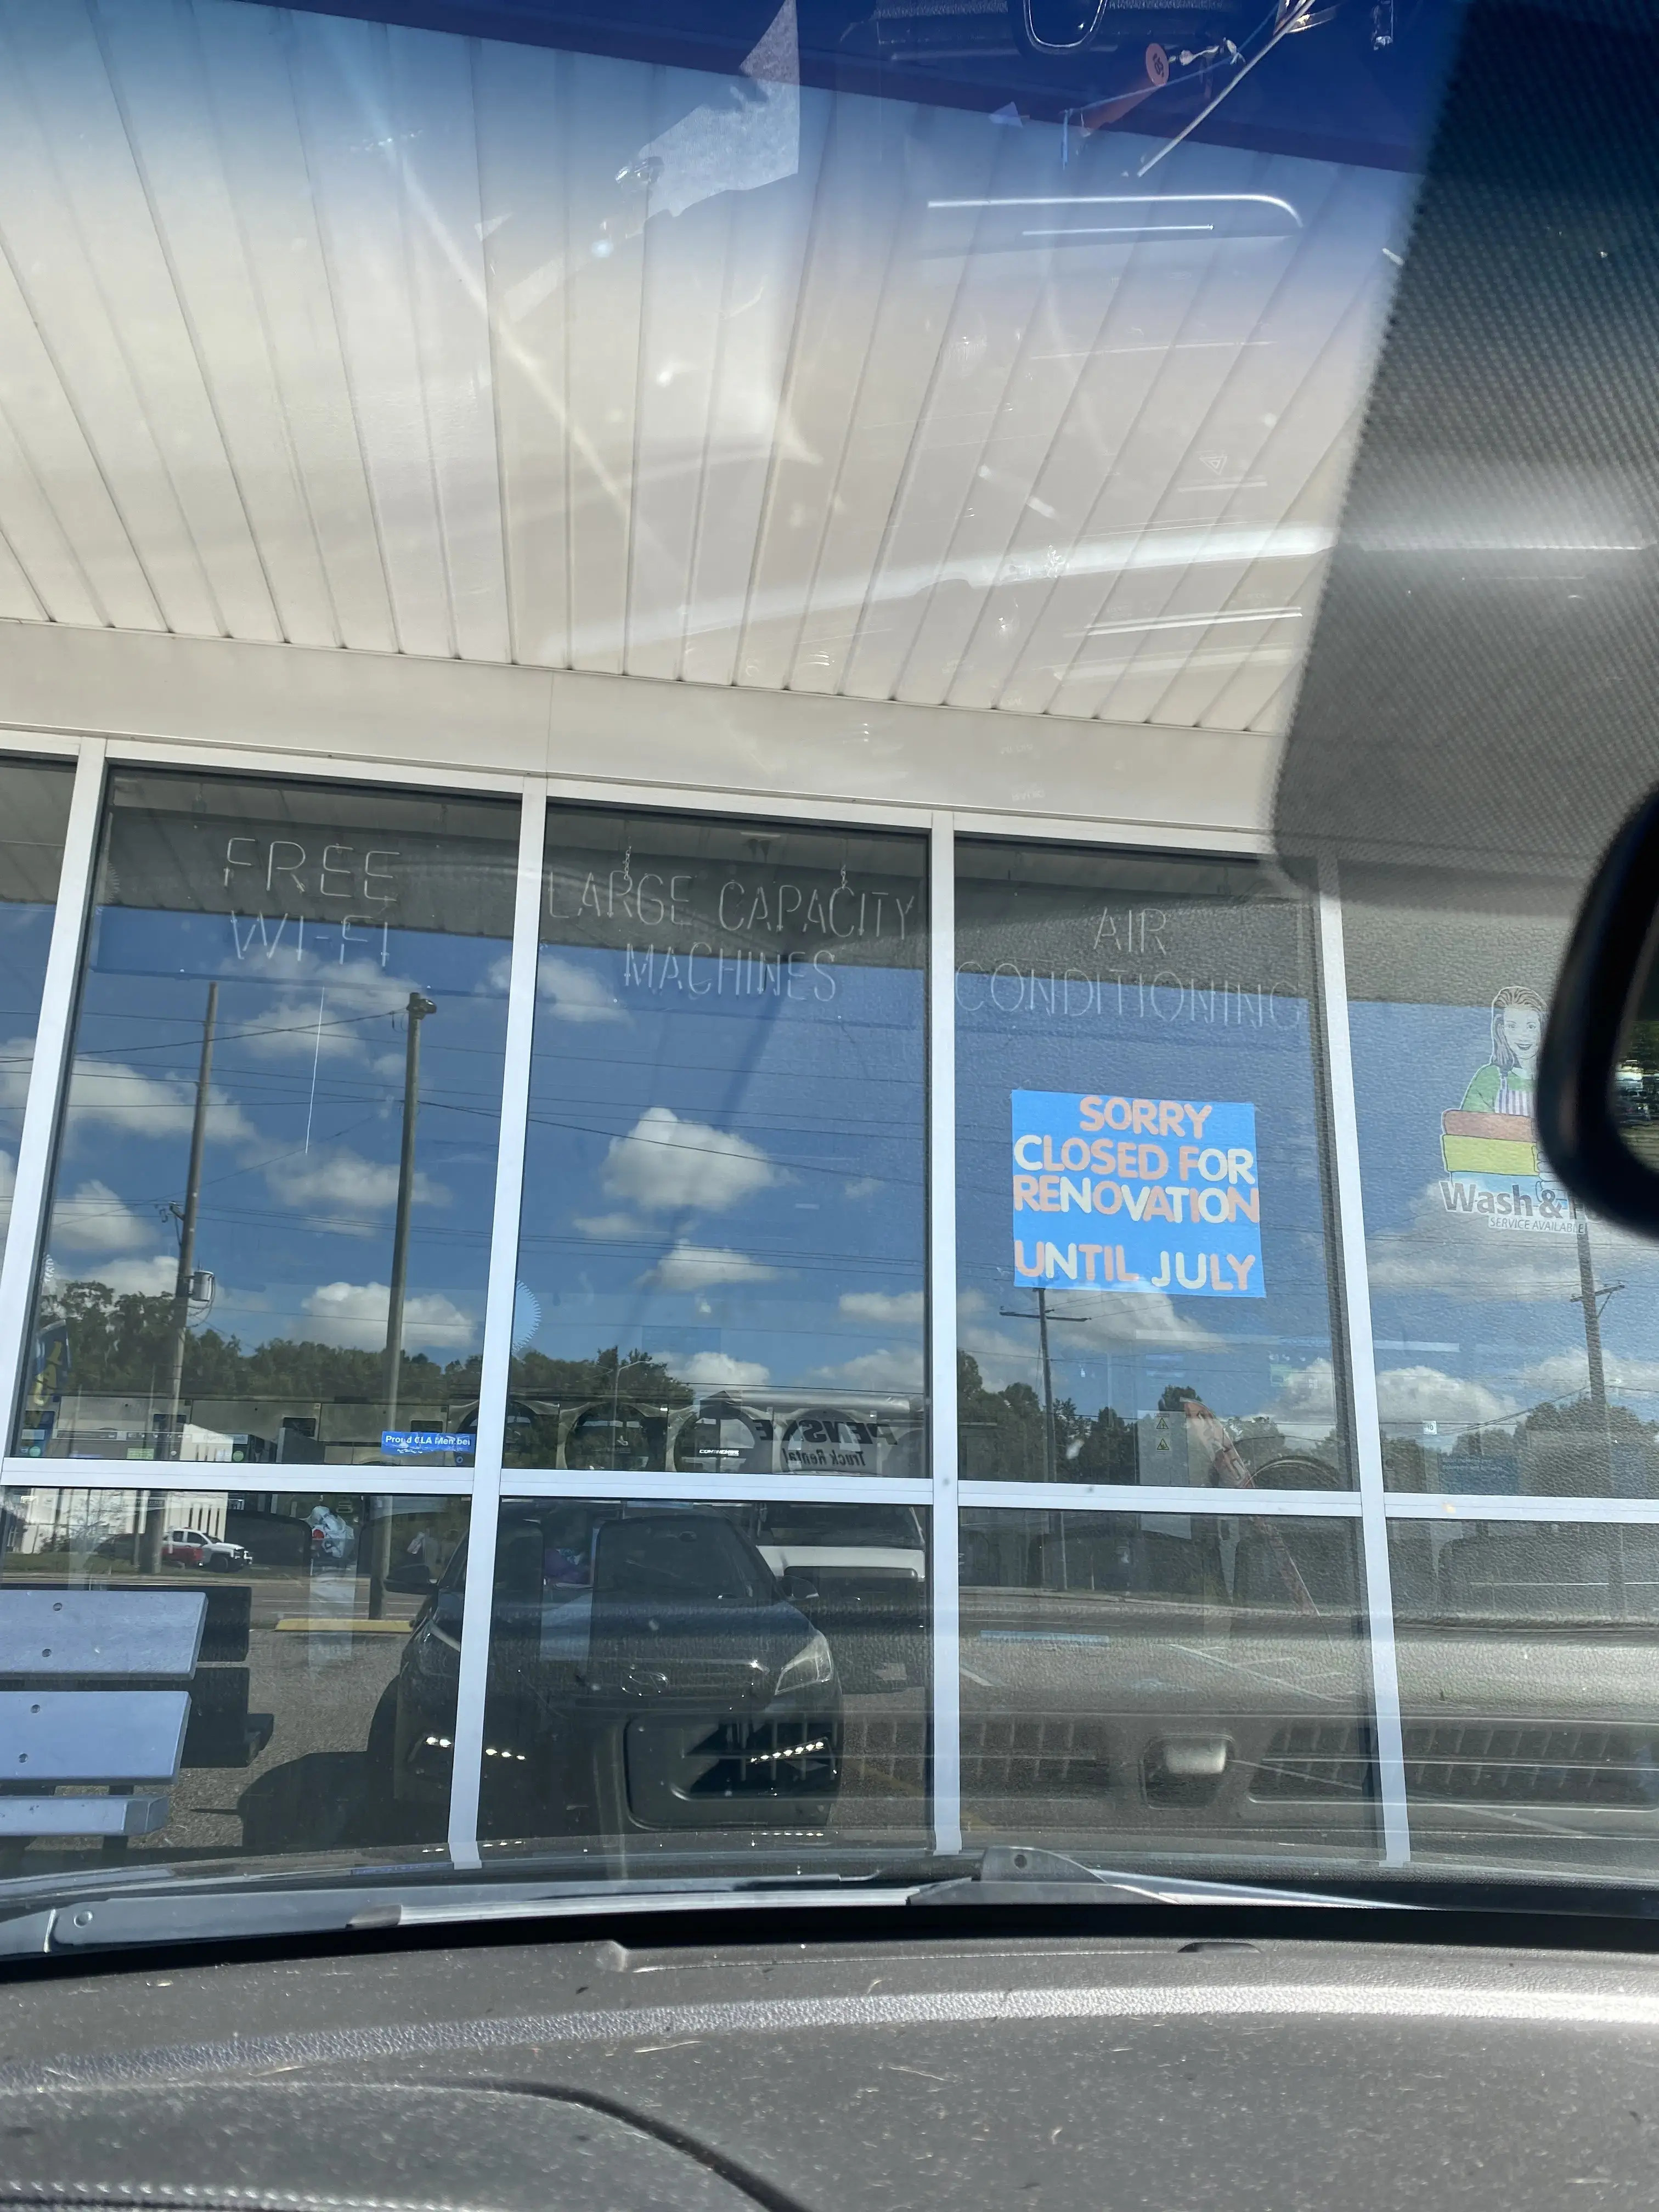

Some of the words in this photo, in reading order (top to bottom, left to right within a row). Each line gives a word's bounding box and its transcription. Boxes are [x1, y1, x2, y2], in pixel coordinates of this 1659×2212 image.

[224, 837, 400, 901] FREE
[548, 870, 693, 926] LARGE
[719, 881, 915, 940] CAPACITY
[231, 910, 388, 968] WI-FI
[1093, 907, 1167, 955] AIR
[624, 941, 836, 1002] MACHINES
[955, 961, 1300, 1029] CONDITIONING
[1079, 1096, 1212, 1139] SORRY
[1014, 1135, 1169, 1180] CLOSED
[1178, 1146, 1256, 1184] FOR
[1013, 1175, 1260, 1223] RENOVATION
[1440, 1182, 1533, 1216] Wash
[1491, 1217, 1530, 1229] SERVICE
[1532, 1220, 1584, 1233] AVAILABLE
[1014, 1240, 1139, 1282] UNTIL
[1151, 1250, 1256, 1291] JULY
